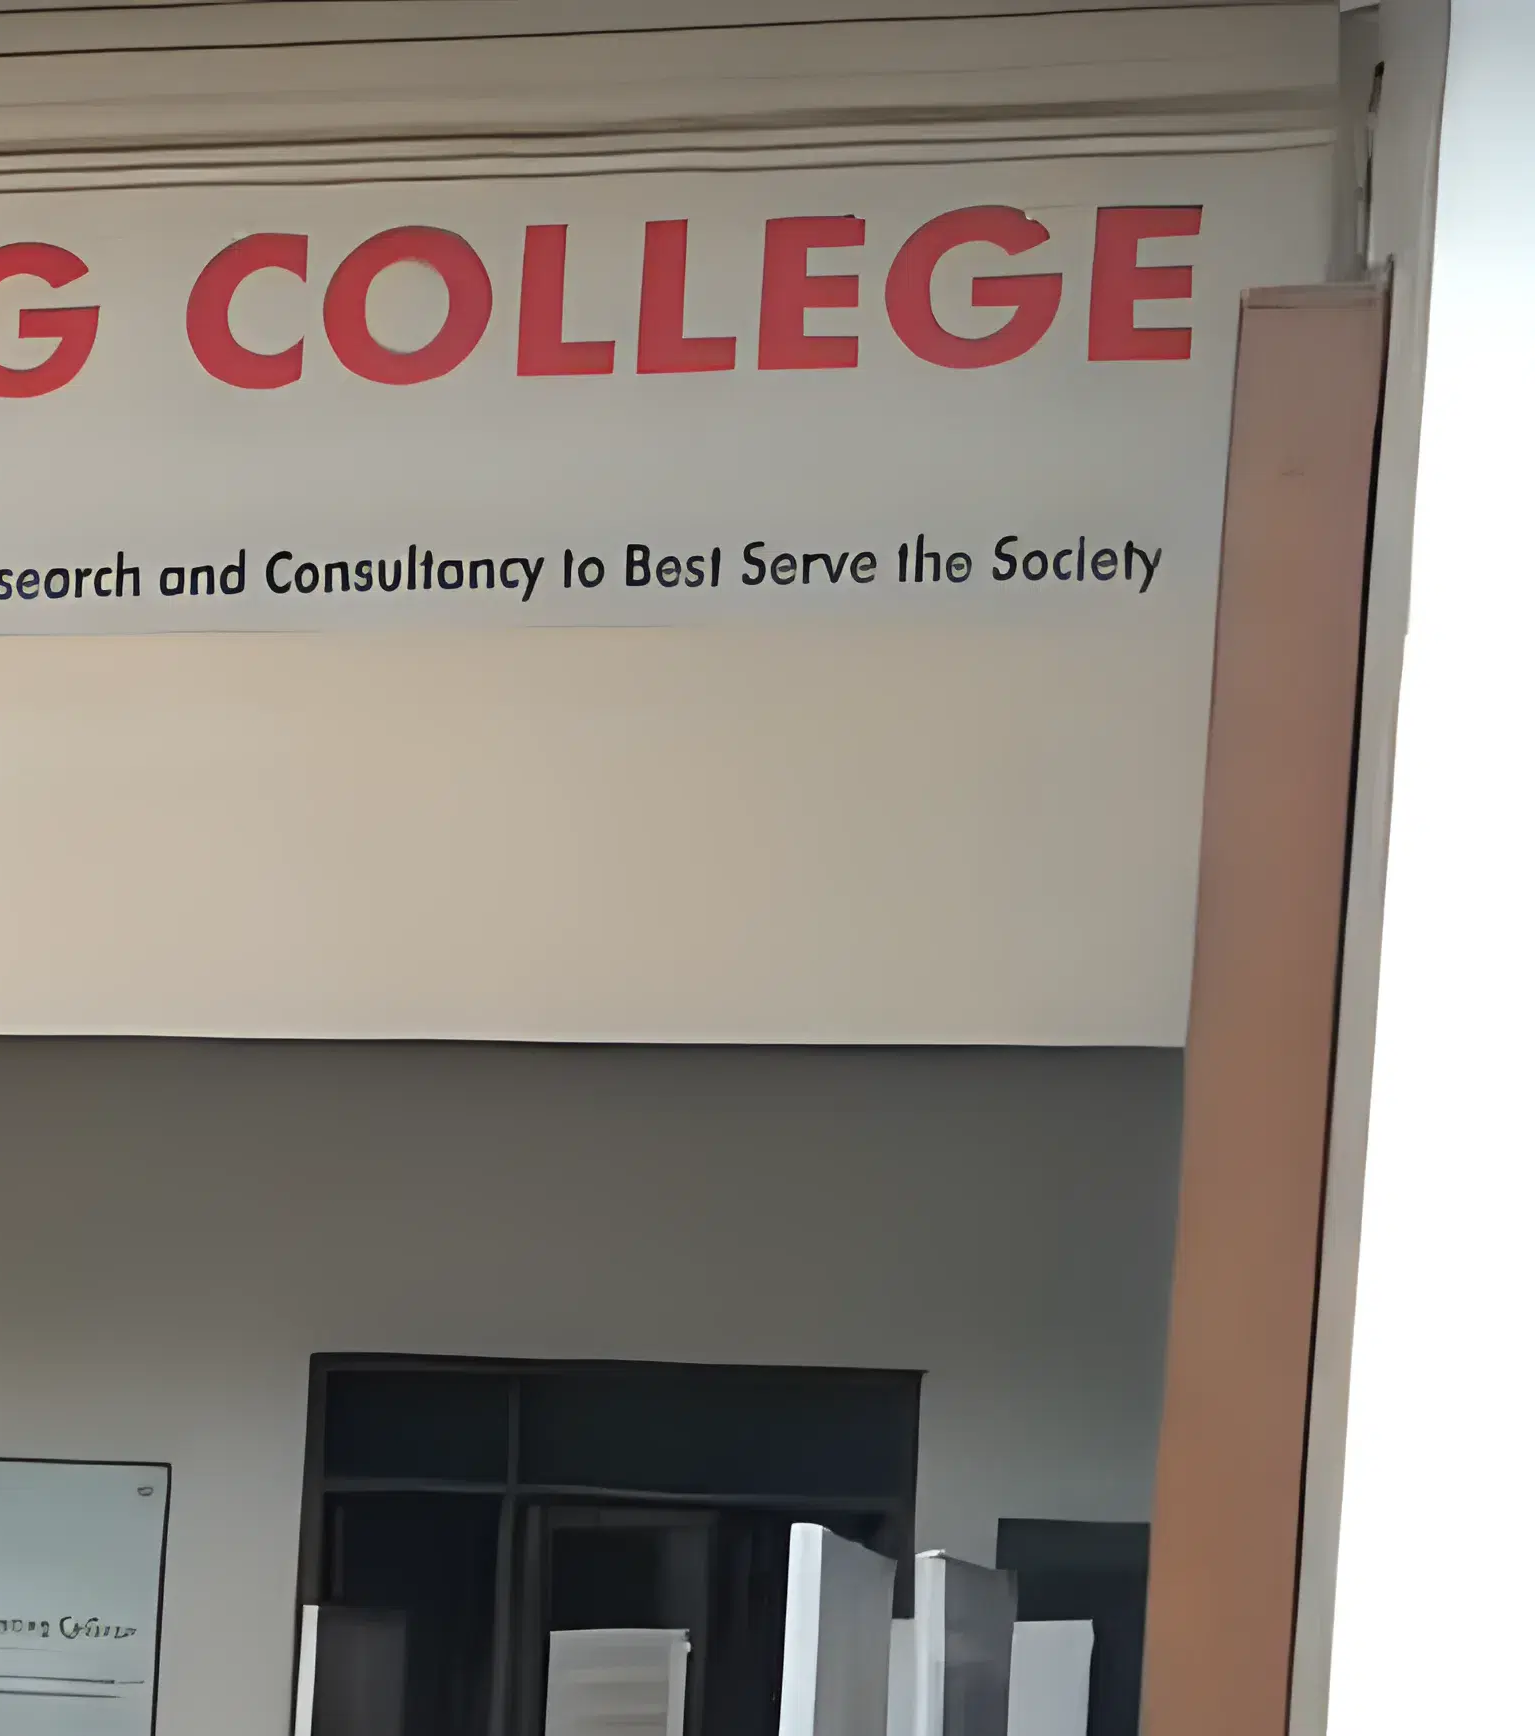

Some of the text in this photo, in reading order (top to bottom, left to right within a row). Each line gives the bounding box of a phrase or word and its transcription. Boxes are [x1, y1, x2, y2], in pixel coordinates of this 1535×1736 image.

[186, 210, 1200, 389] COLLEGE
[160, 549, 245, 596] and
[266, 544, 544, 602] Consultancy
[564, 549, 604, 588] to
[626, 544, 720, 587] Best
[742, 541, 877, 585] Serve
[898, 533, 972, 583] the
[992, 536, 1162, 593] Society
